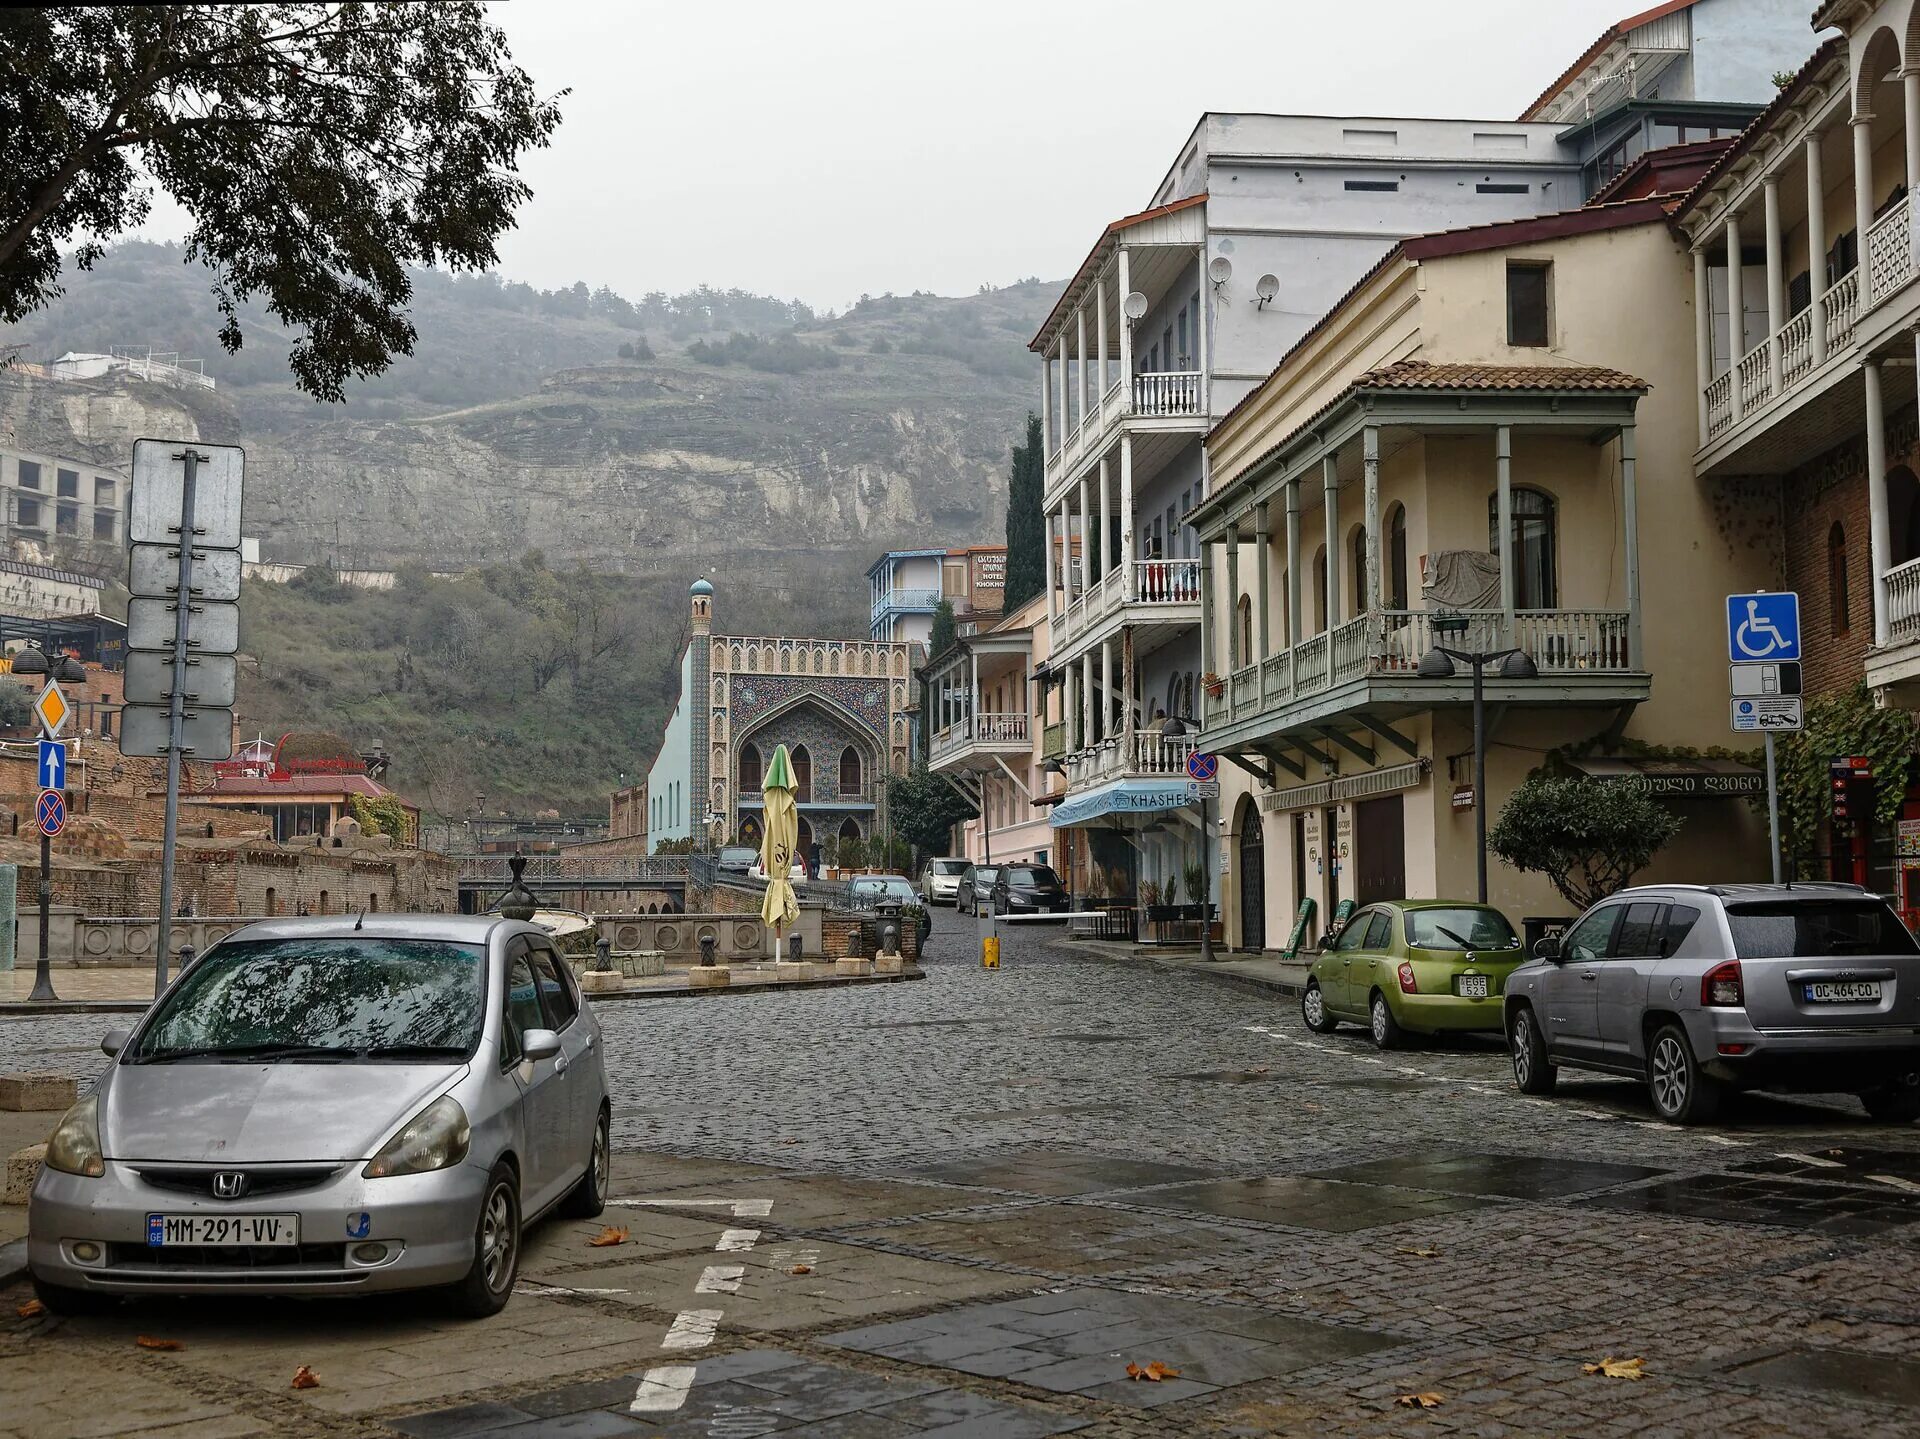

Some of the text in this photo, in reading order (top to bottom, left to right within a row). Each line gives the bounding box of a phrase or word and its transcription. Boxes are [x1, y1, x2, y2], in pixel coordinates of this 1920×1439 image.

[1704, 776, 1762, 790] ღვინო
[1466, 977, 1486, 987] EGE
[1466, 987, 1486, 995] 523
[166, 1219, 280, 1242] MM-291-VV
[150, 1232, 162, 1242] GE
